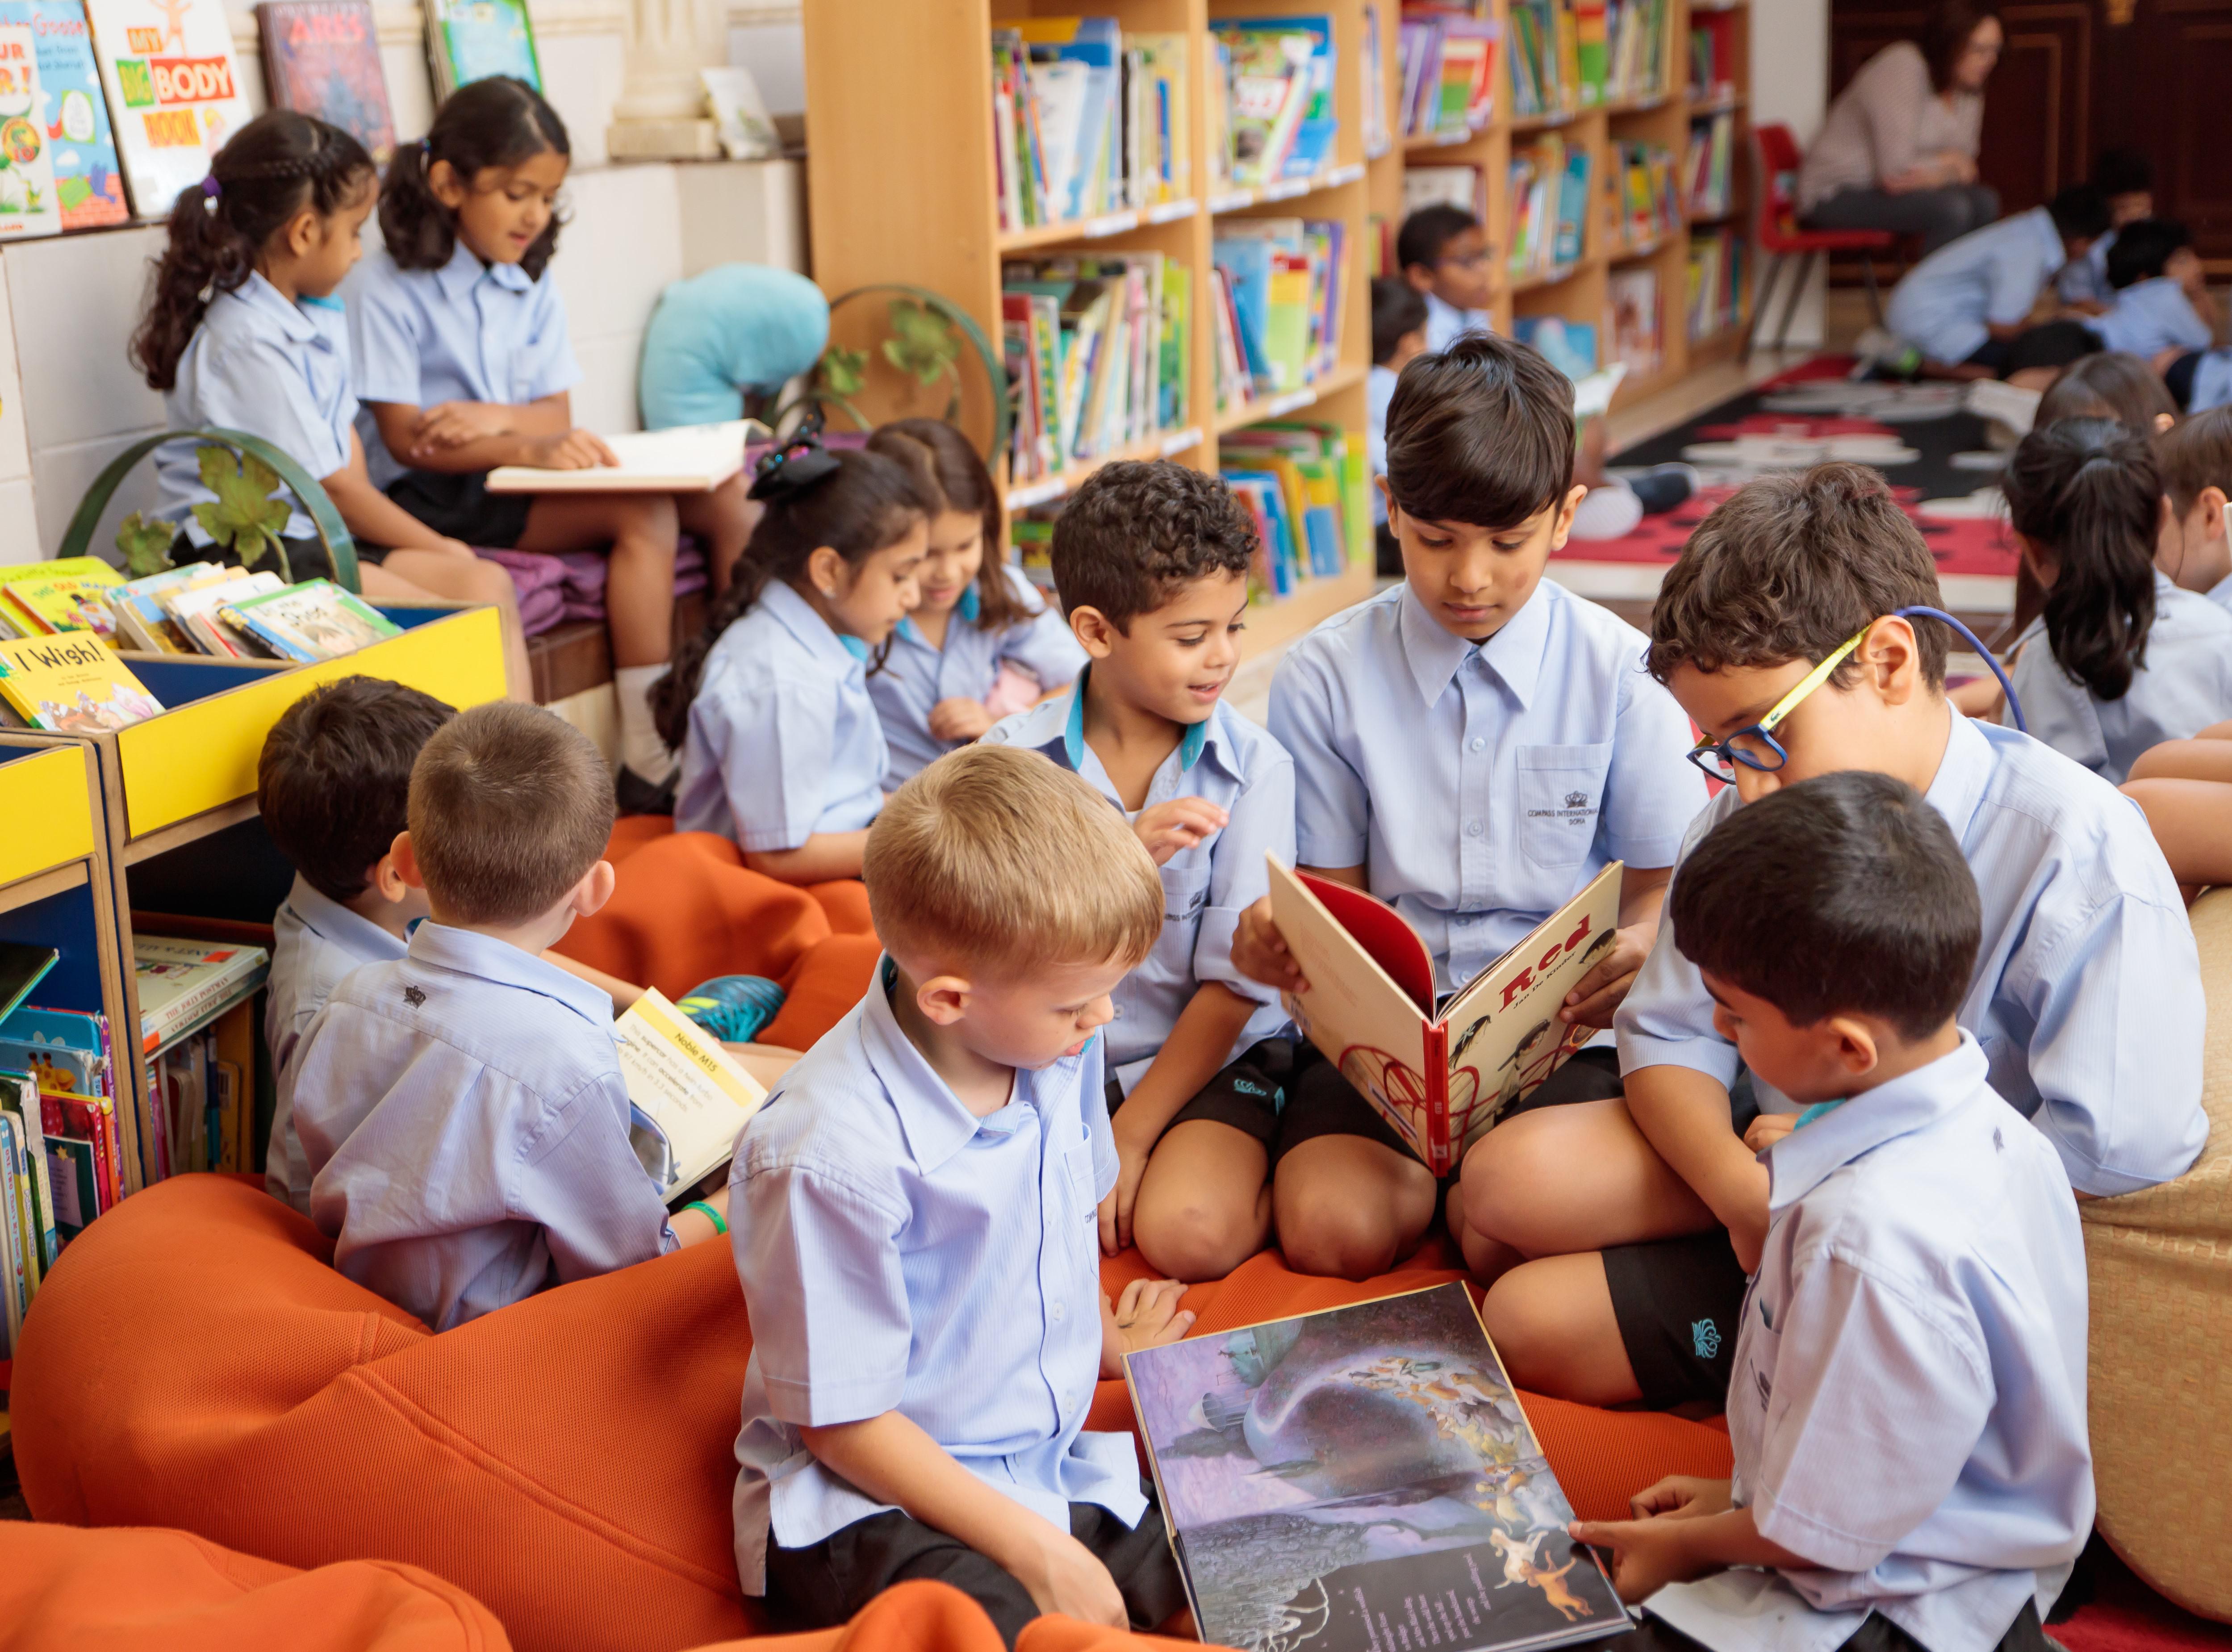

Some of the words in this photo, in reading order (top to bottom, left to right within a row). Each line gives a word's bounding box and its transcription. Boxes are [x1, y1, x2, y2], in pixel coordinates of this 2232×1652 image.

[153, 62, 230, 100] BODY
[14, 652, 31, 672] I
[28, 640, 105, 669] Wish!
[1498, 913, 1592, 1014] Red
[1513, 993, 1530, 1010] Jan
[1532, 980, 1544, 992] De
[1546, 951, 1576, 979] Kinder
[641, 1036, 666, 1058] supercar
[675, 1033, 698, 1056] Noble
[699, 1055, 717, 1071] M15
[647, 1057, 659, 1067] can
[658, 1068, 689, 1095] accelerate
[689, 1094, 703, 1109] from
[13, 1222, 18, 1234] My
